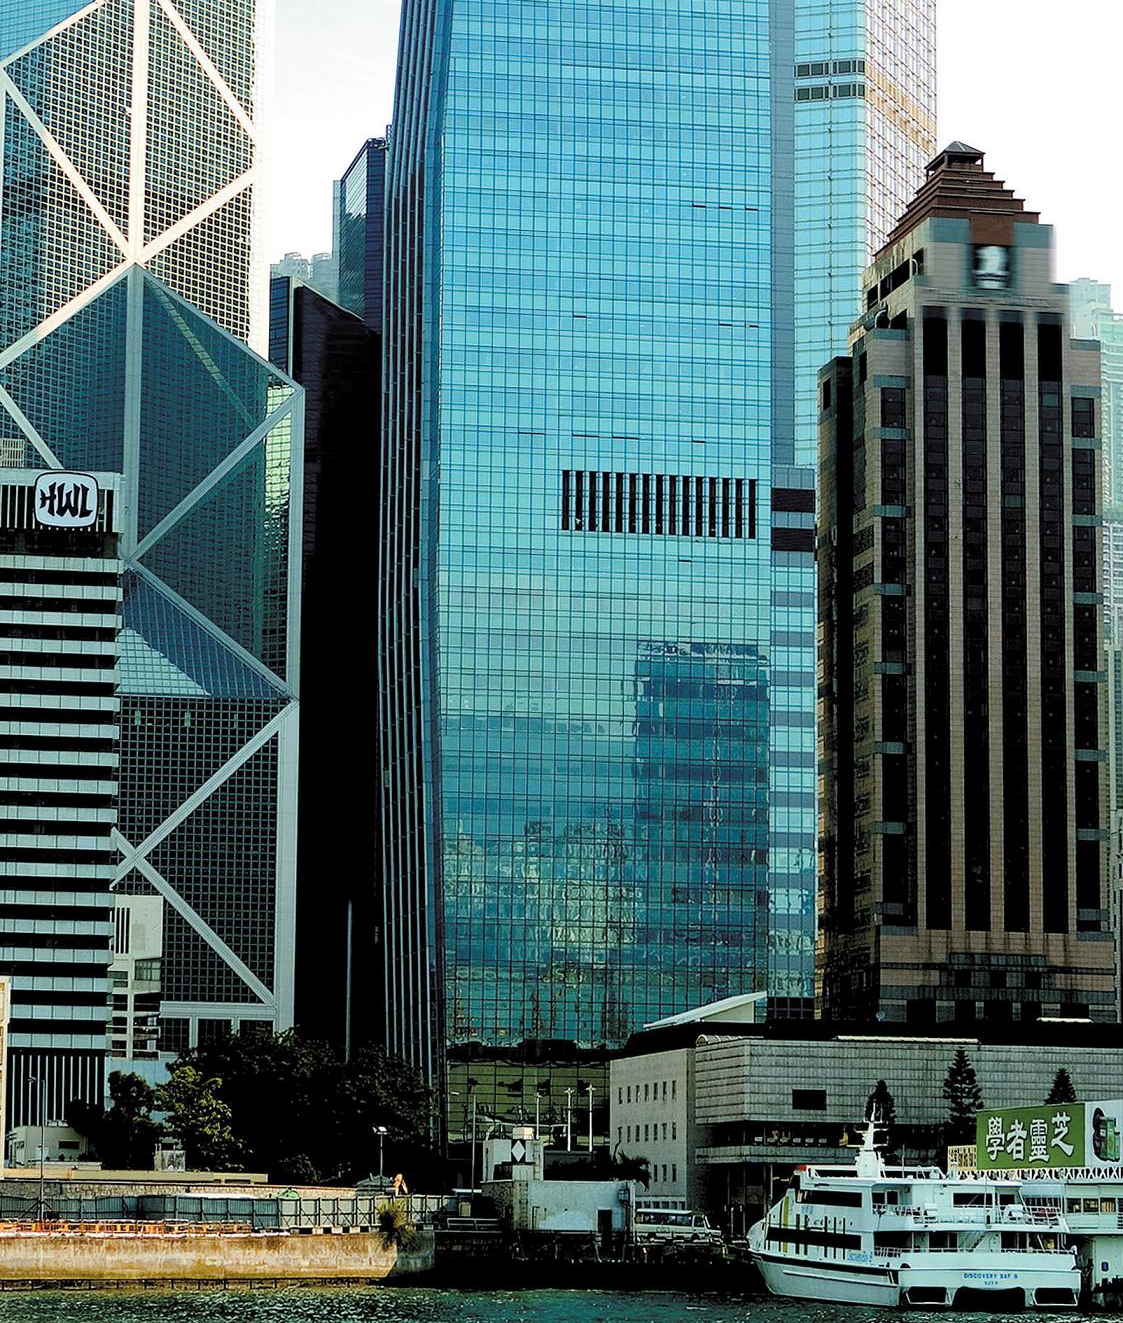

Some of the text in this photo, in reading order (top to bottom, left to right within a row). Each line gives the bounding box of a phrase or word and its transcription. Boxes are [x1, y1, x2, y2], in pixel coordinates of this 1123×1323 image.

[39, 482, 94, 518] HWL
[985, 1111, 1075, 1162] 學者靈芝
